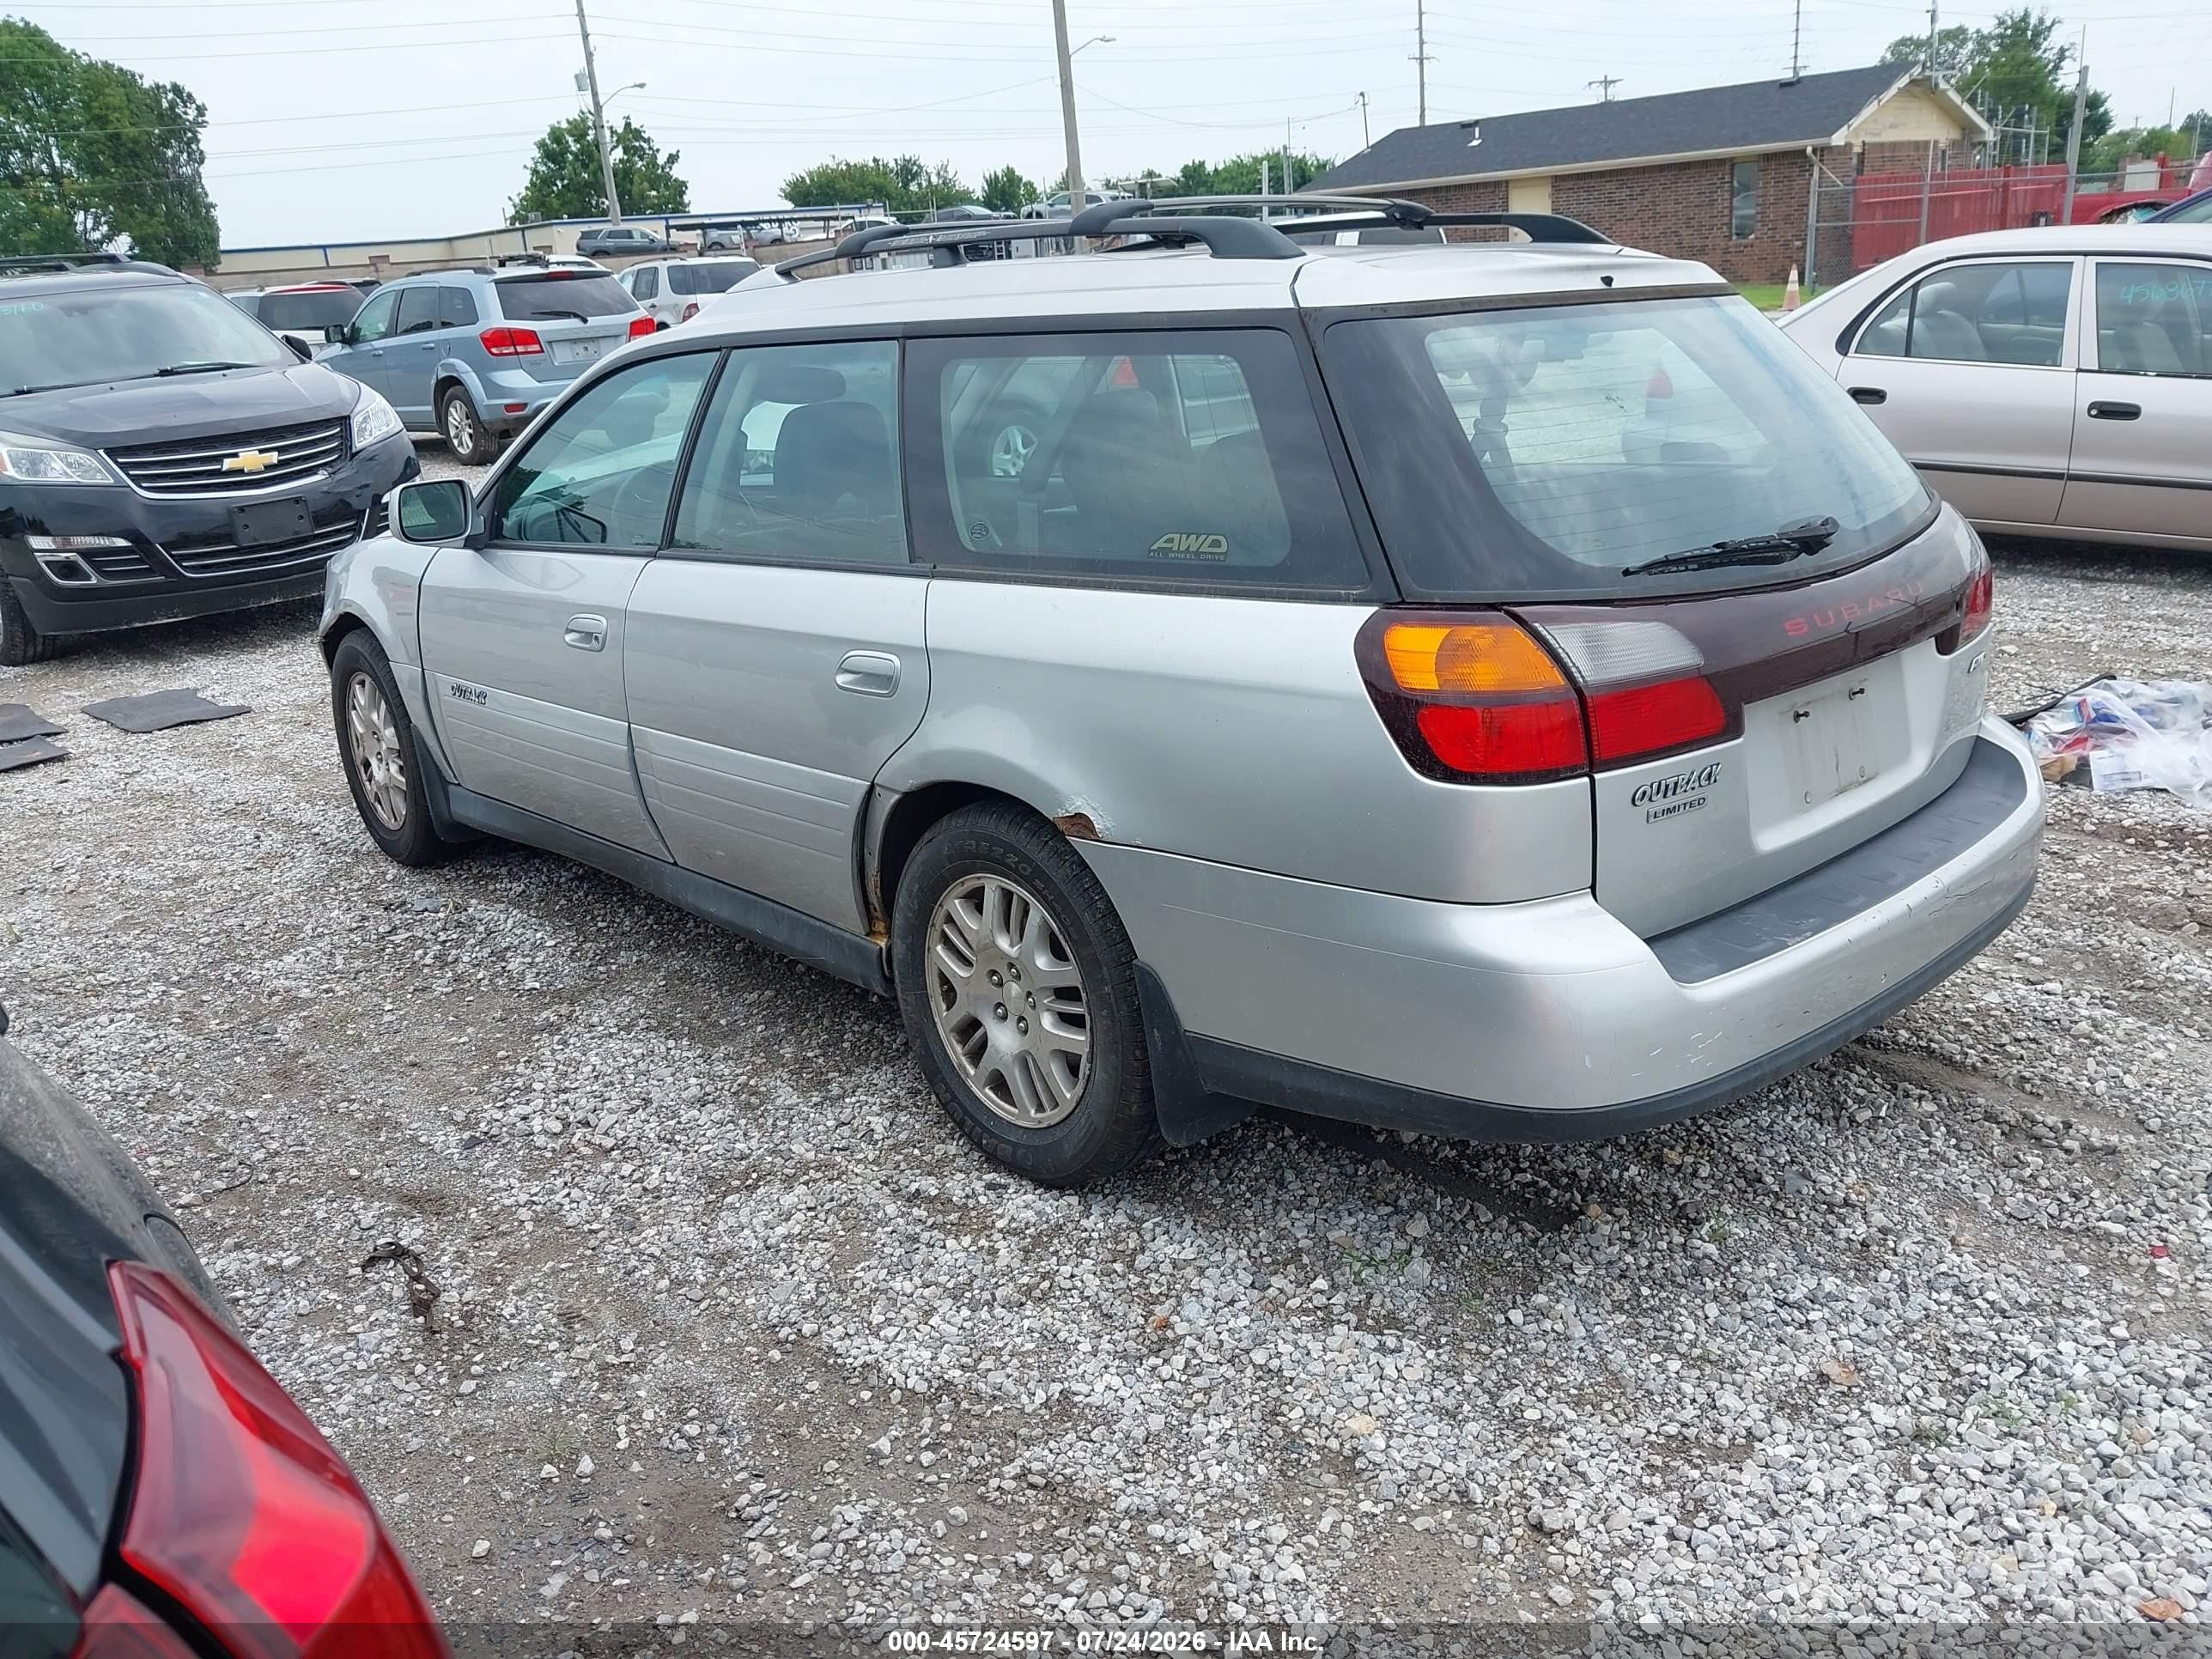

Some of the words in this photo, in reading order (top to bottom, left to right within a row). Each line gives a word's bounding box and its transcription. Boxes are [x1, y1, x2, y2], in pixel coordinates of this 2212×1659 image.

[1149, 532, 1229, 553] AWD
[1784, 580, 1923, 637] SUBARU
[1632, 762, 1723, 807] OUTBACK
[1652, 797, 1706, 820] LIMITED
